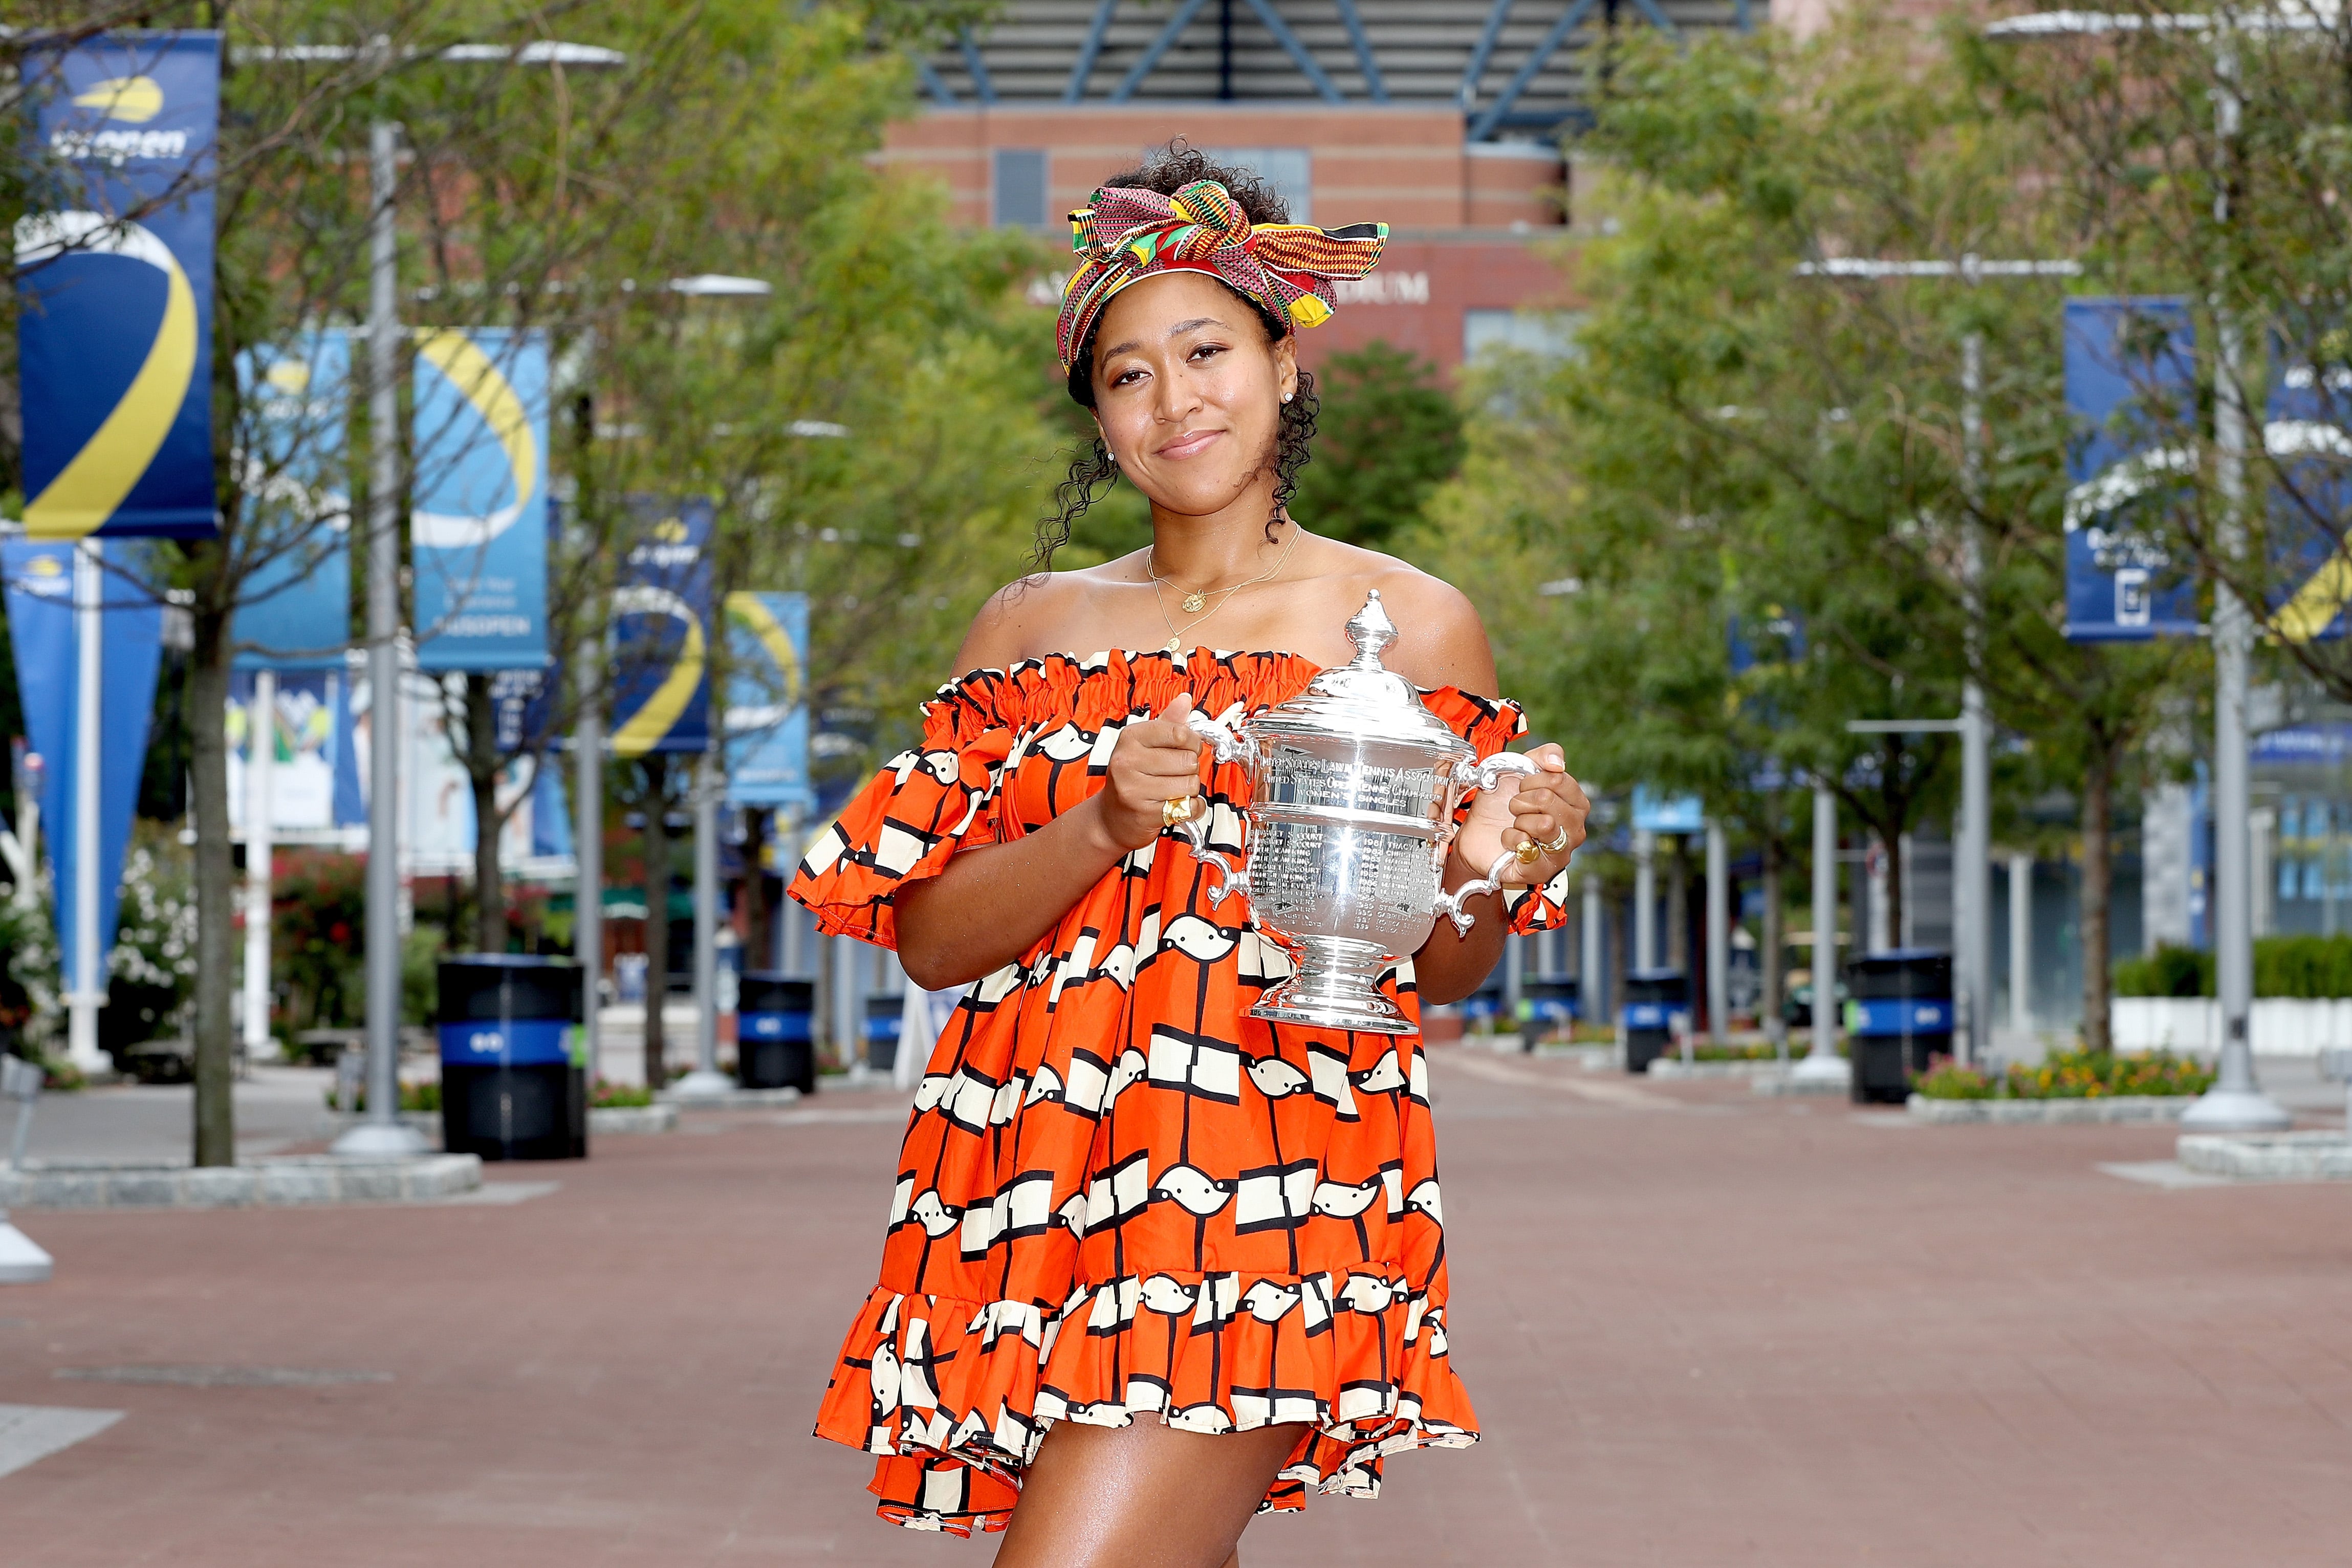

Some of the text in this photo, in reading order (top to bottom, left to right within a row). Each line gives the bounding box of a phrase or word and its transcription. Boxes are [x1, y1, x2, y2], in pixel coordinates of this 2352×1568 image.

[1333, 271, 1429, 304] DIUM
[1321, 758, 1354, 774] LAWN
[1354, 763, 1396, 778] TENNIS
[1358, 794, 1407, 807] SINGLES
[1363, 847, 1382, 855] 1982
[1364, 838, 1382, 848] 1981
[1387, 841, 1413, 851] TRACY
